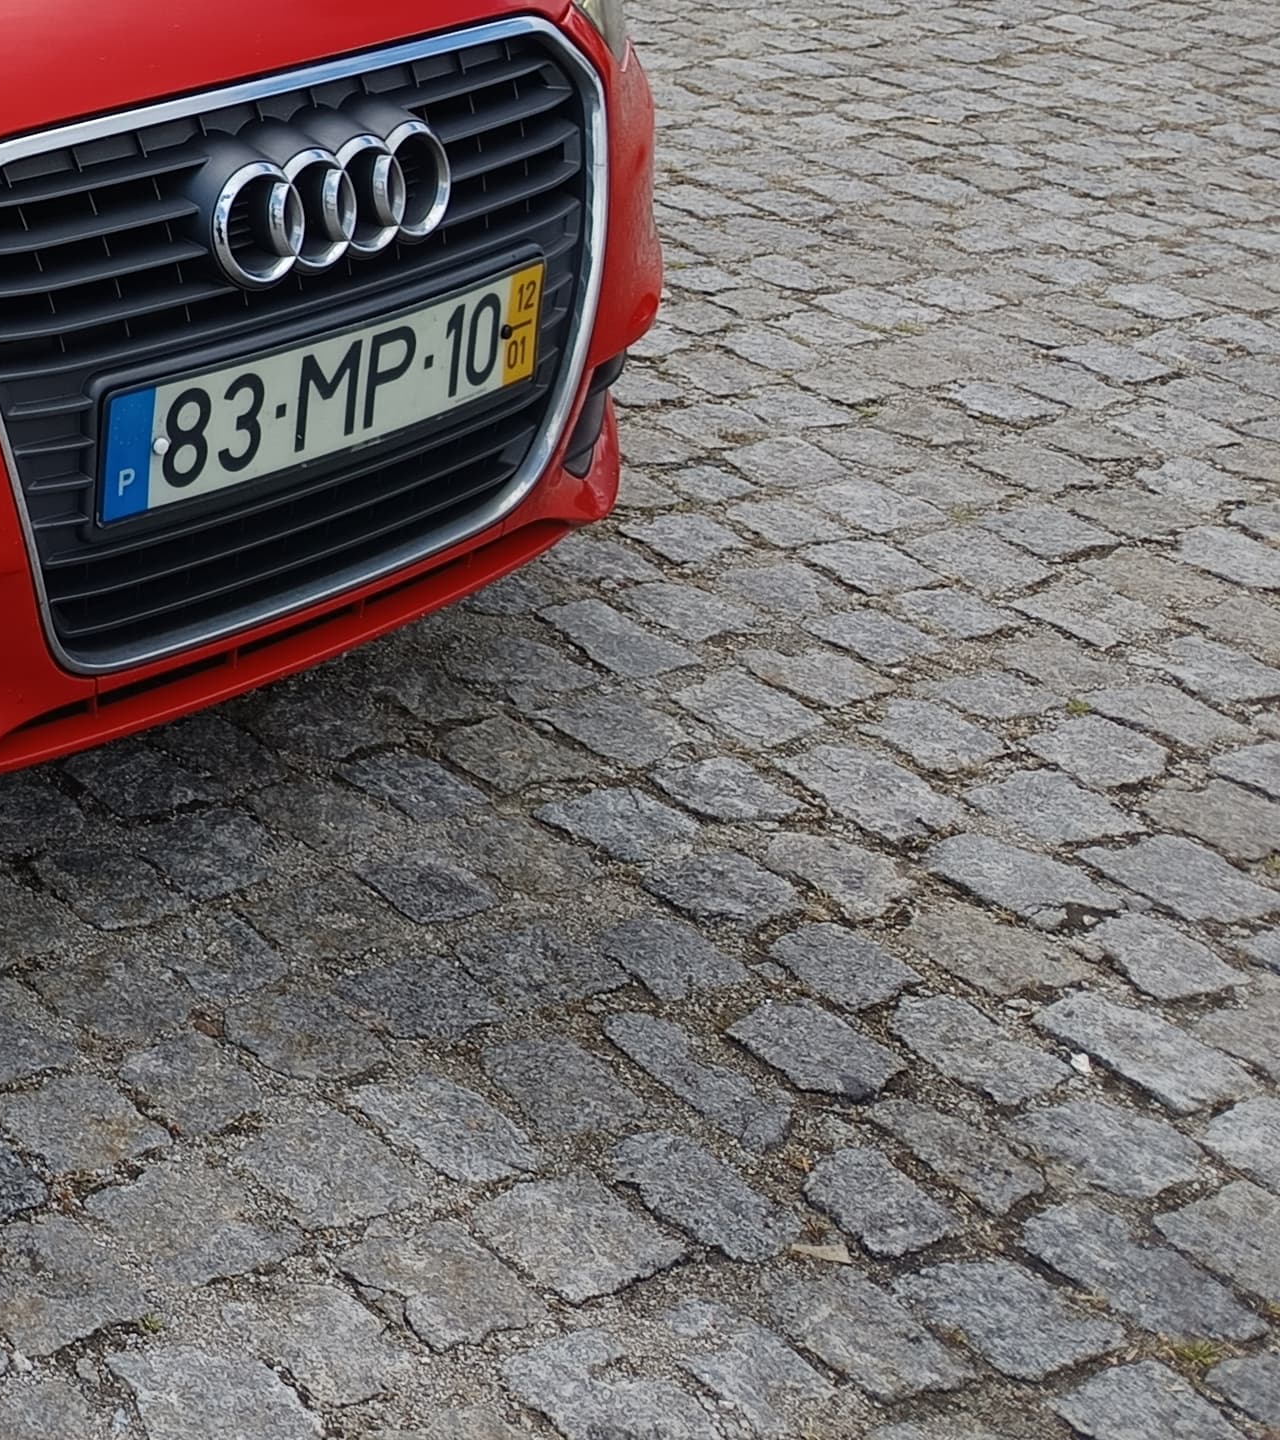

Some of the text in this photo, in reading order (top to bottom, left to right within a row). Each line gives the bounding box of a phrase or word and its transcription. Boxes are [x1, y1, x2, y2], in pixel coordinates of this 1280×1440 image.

[517, 279, 537, 313] 12
[506, 335, 527, 370] 01
[117, 468, 136, 497] P
